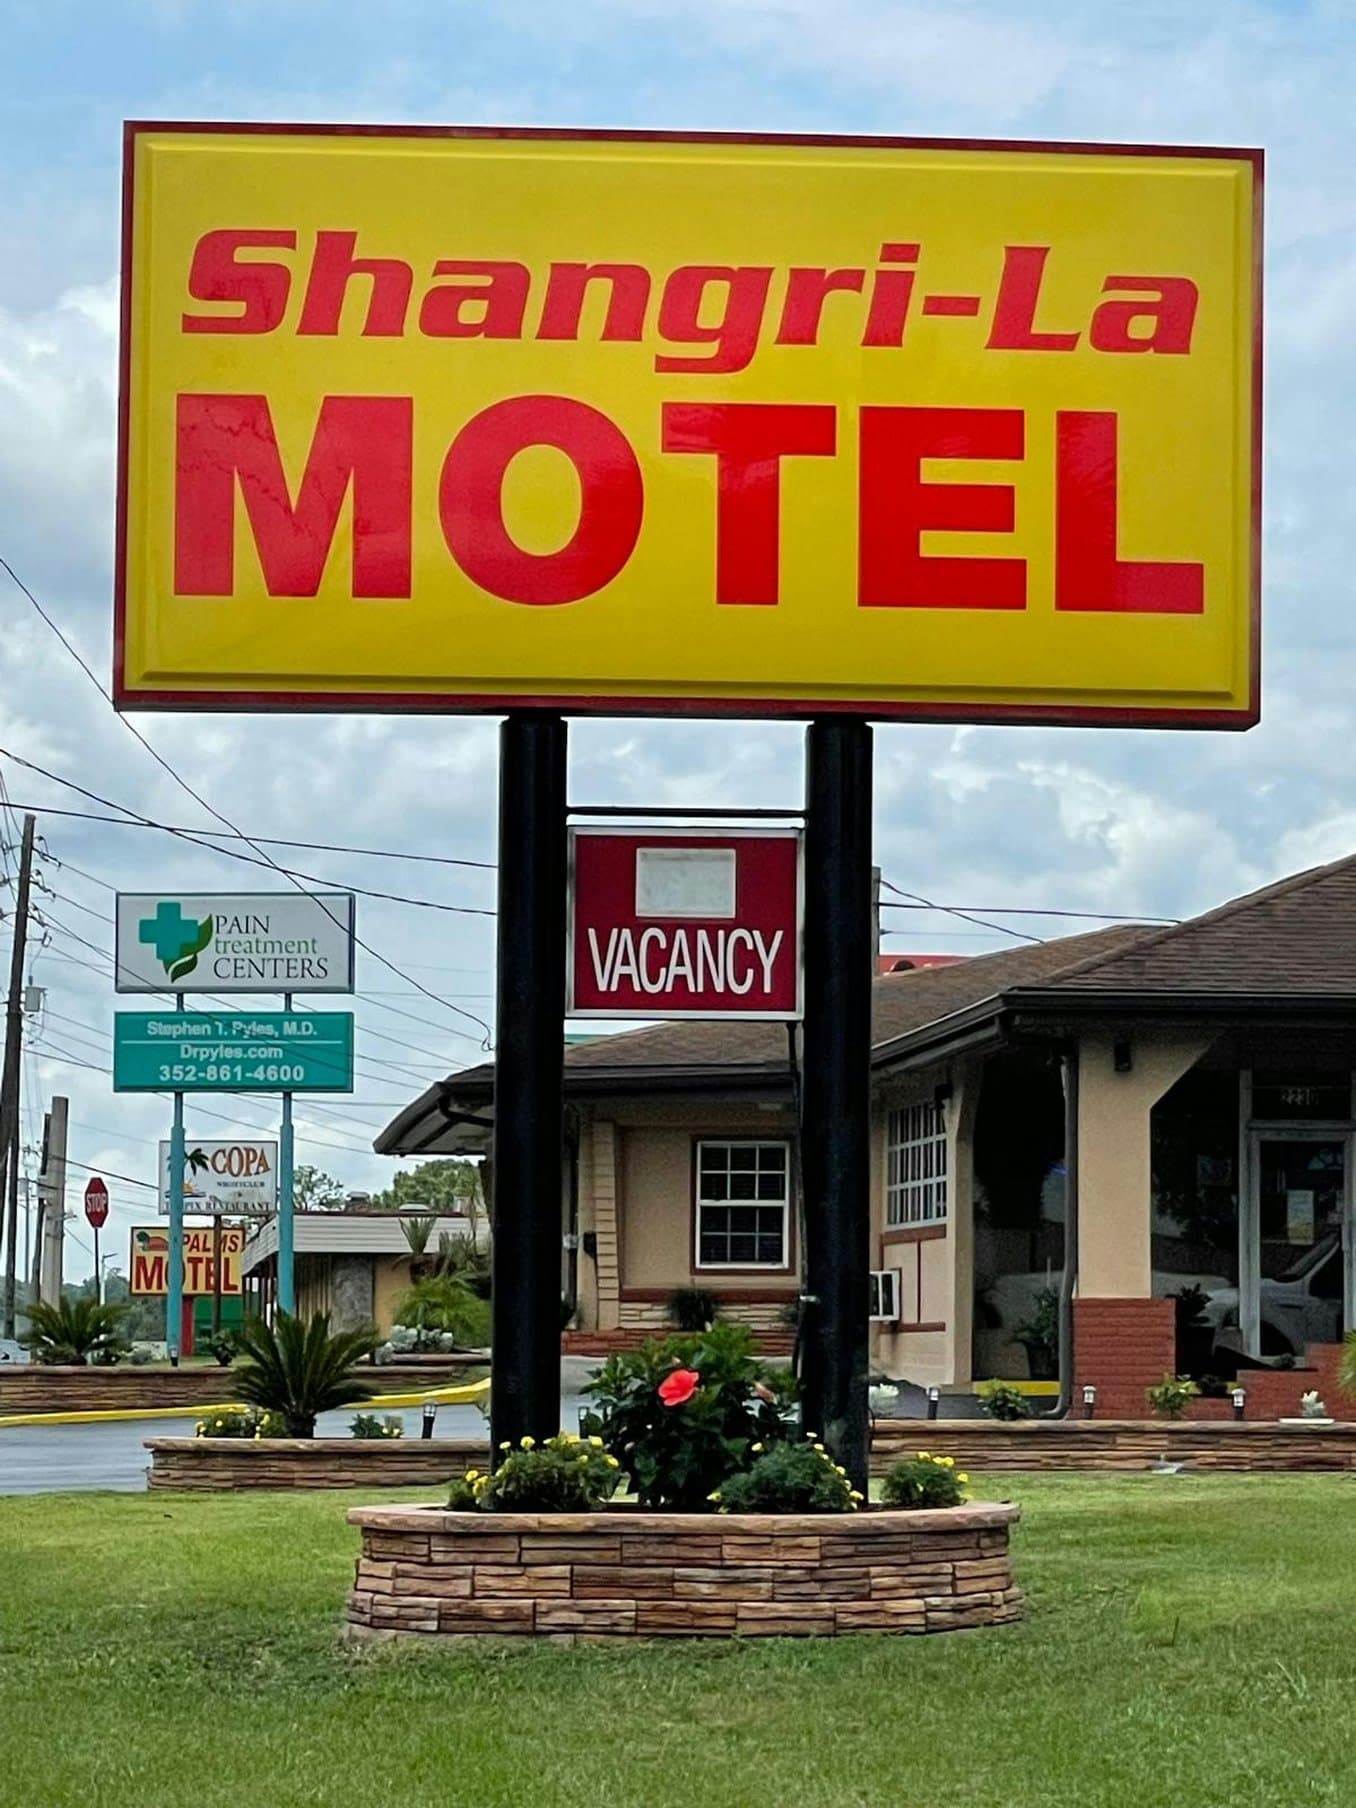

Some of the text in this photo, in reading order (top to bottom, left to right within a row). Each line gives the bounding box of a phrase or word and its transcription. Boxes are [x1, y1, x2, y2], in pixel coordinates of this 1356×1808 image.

[181, 229, 1200, 373] Shangri-La
[174, 393, 1204, 614] MOTEL
[216, 915, 270, 934] PAIN
[215, 937, 317, 954] treatment
[213, 957, 328, 979] CENTERS
[587, 927, 784, 994] VACANCY
[147, 1021, 211, 1038] Stephen
[283, 1021, 318, 1036] M.D.
[180, 1044, 283, 1062] Drpyles.com
[159, 1065, 305, 1081] 352-861-4600
[211, 1146, 271, 1177] COPA
[87, 1193, 107, 1212] STOP
